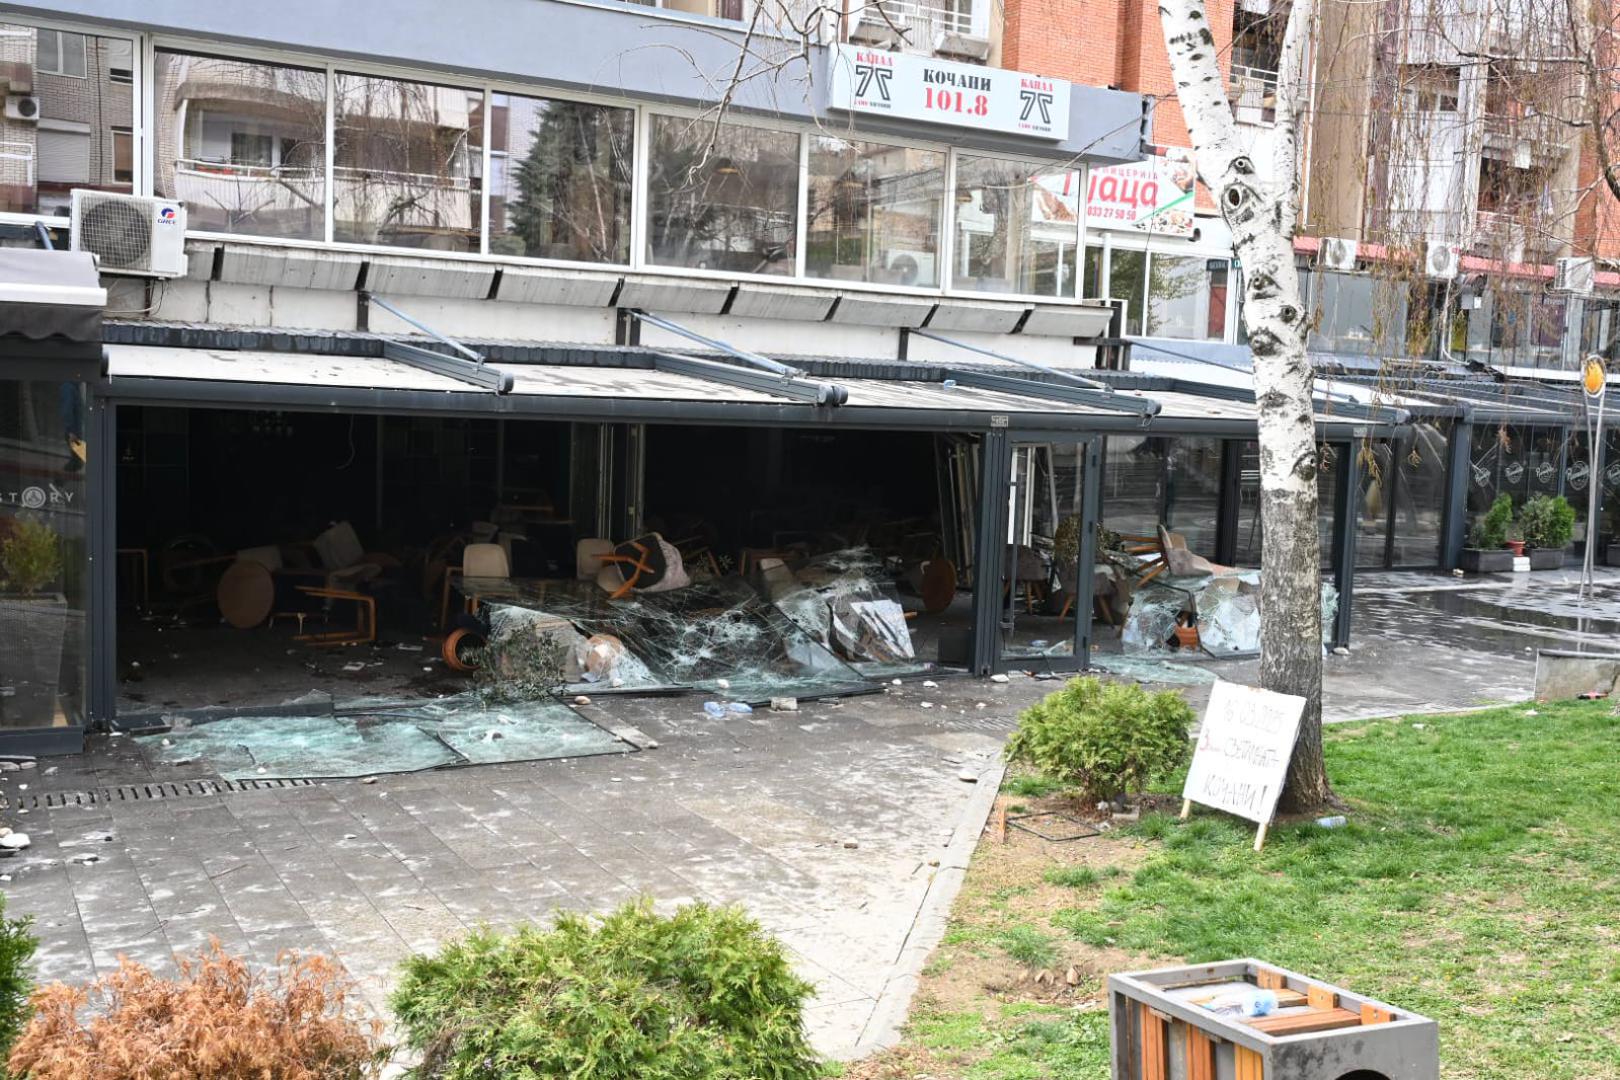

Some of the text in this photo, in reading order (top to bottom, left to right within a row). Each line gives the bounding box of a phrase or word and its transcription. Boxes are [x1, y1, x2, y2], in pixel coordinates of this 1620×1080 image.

[923, 68, 991, 92] КОЧАНИ
[1020, 79, 1053, 92] КАНАЛ
[924, 87, 988, 116] 101.8
[1087, 206, 1137, 221] 033 27 50 50
[0, 486, 74, 508] TORY
